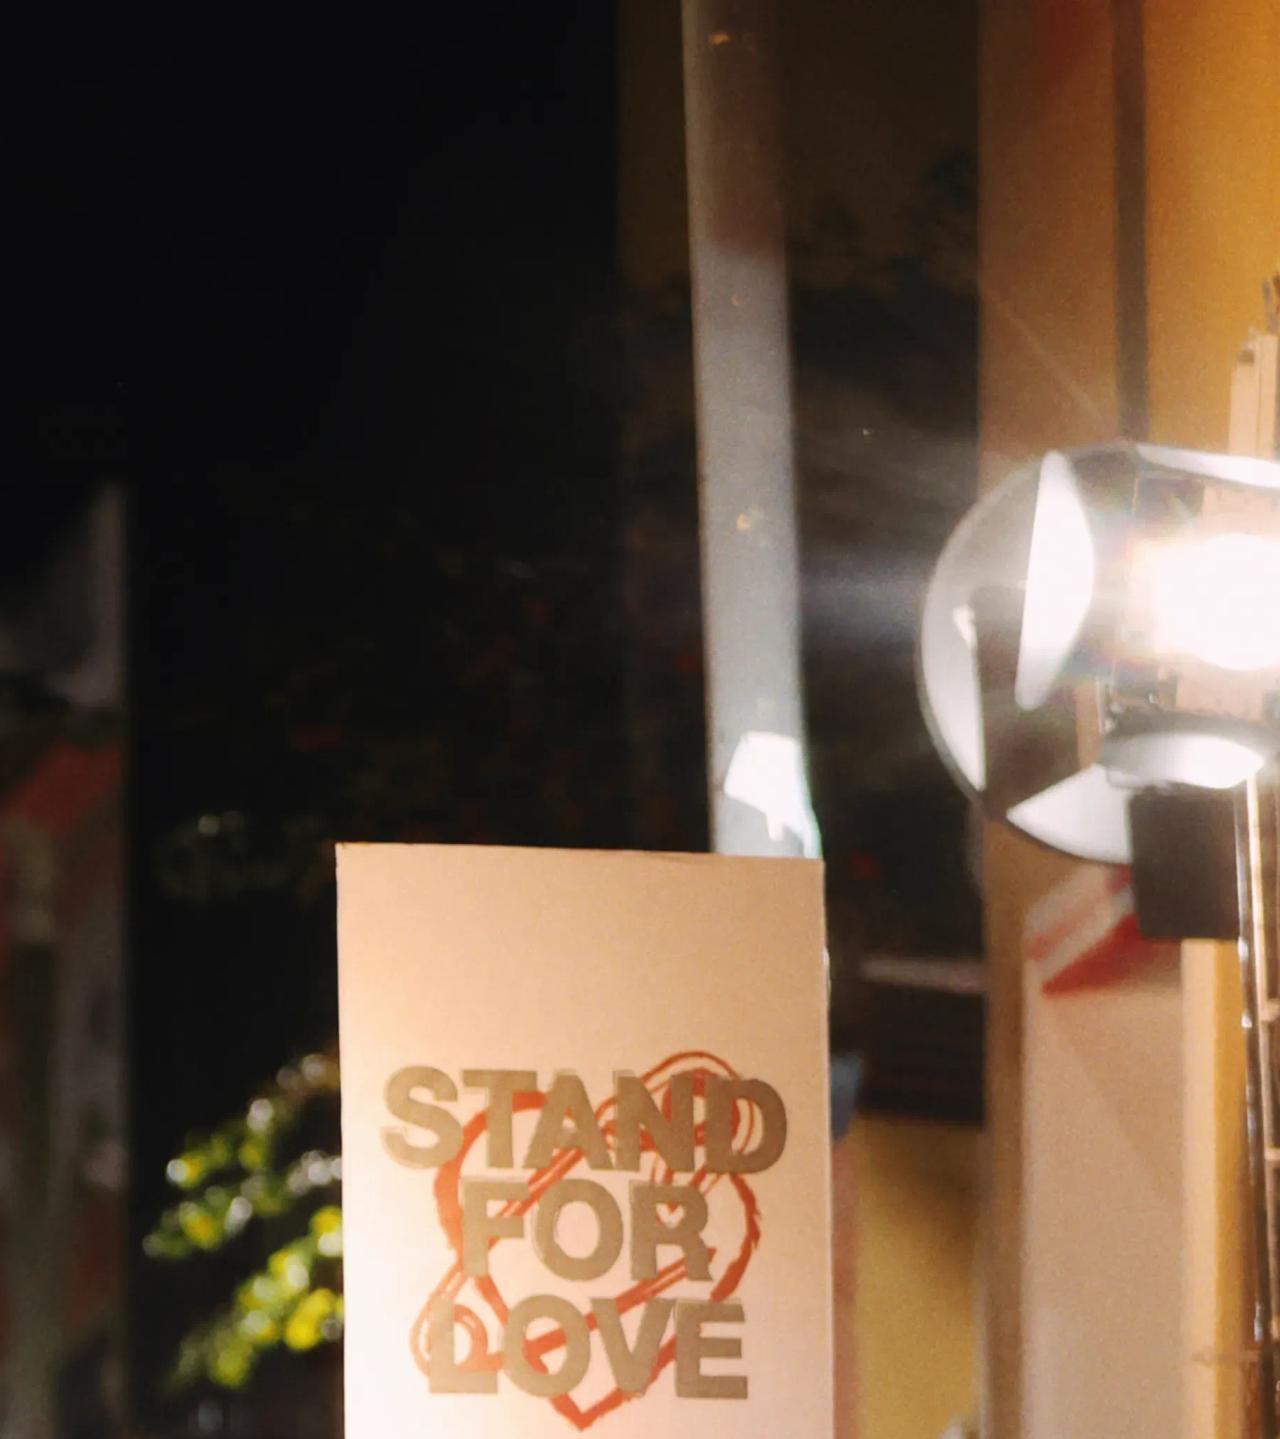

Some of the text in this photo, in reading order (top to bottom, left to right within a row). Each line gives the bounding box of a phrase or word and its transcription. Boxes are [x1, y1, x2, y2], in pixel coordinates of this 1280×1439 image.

[382, 1064, 788, 1175] STAND
[459, 1176, 713, 1283] FOR
[427, 1293, 749, 1400] LOVE
